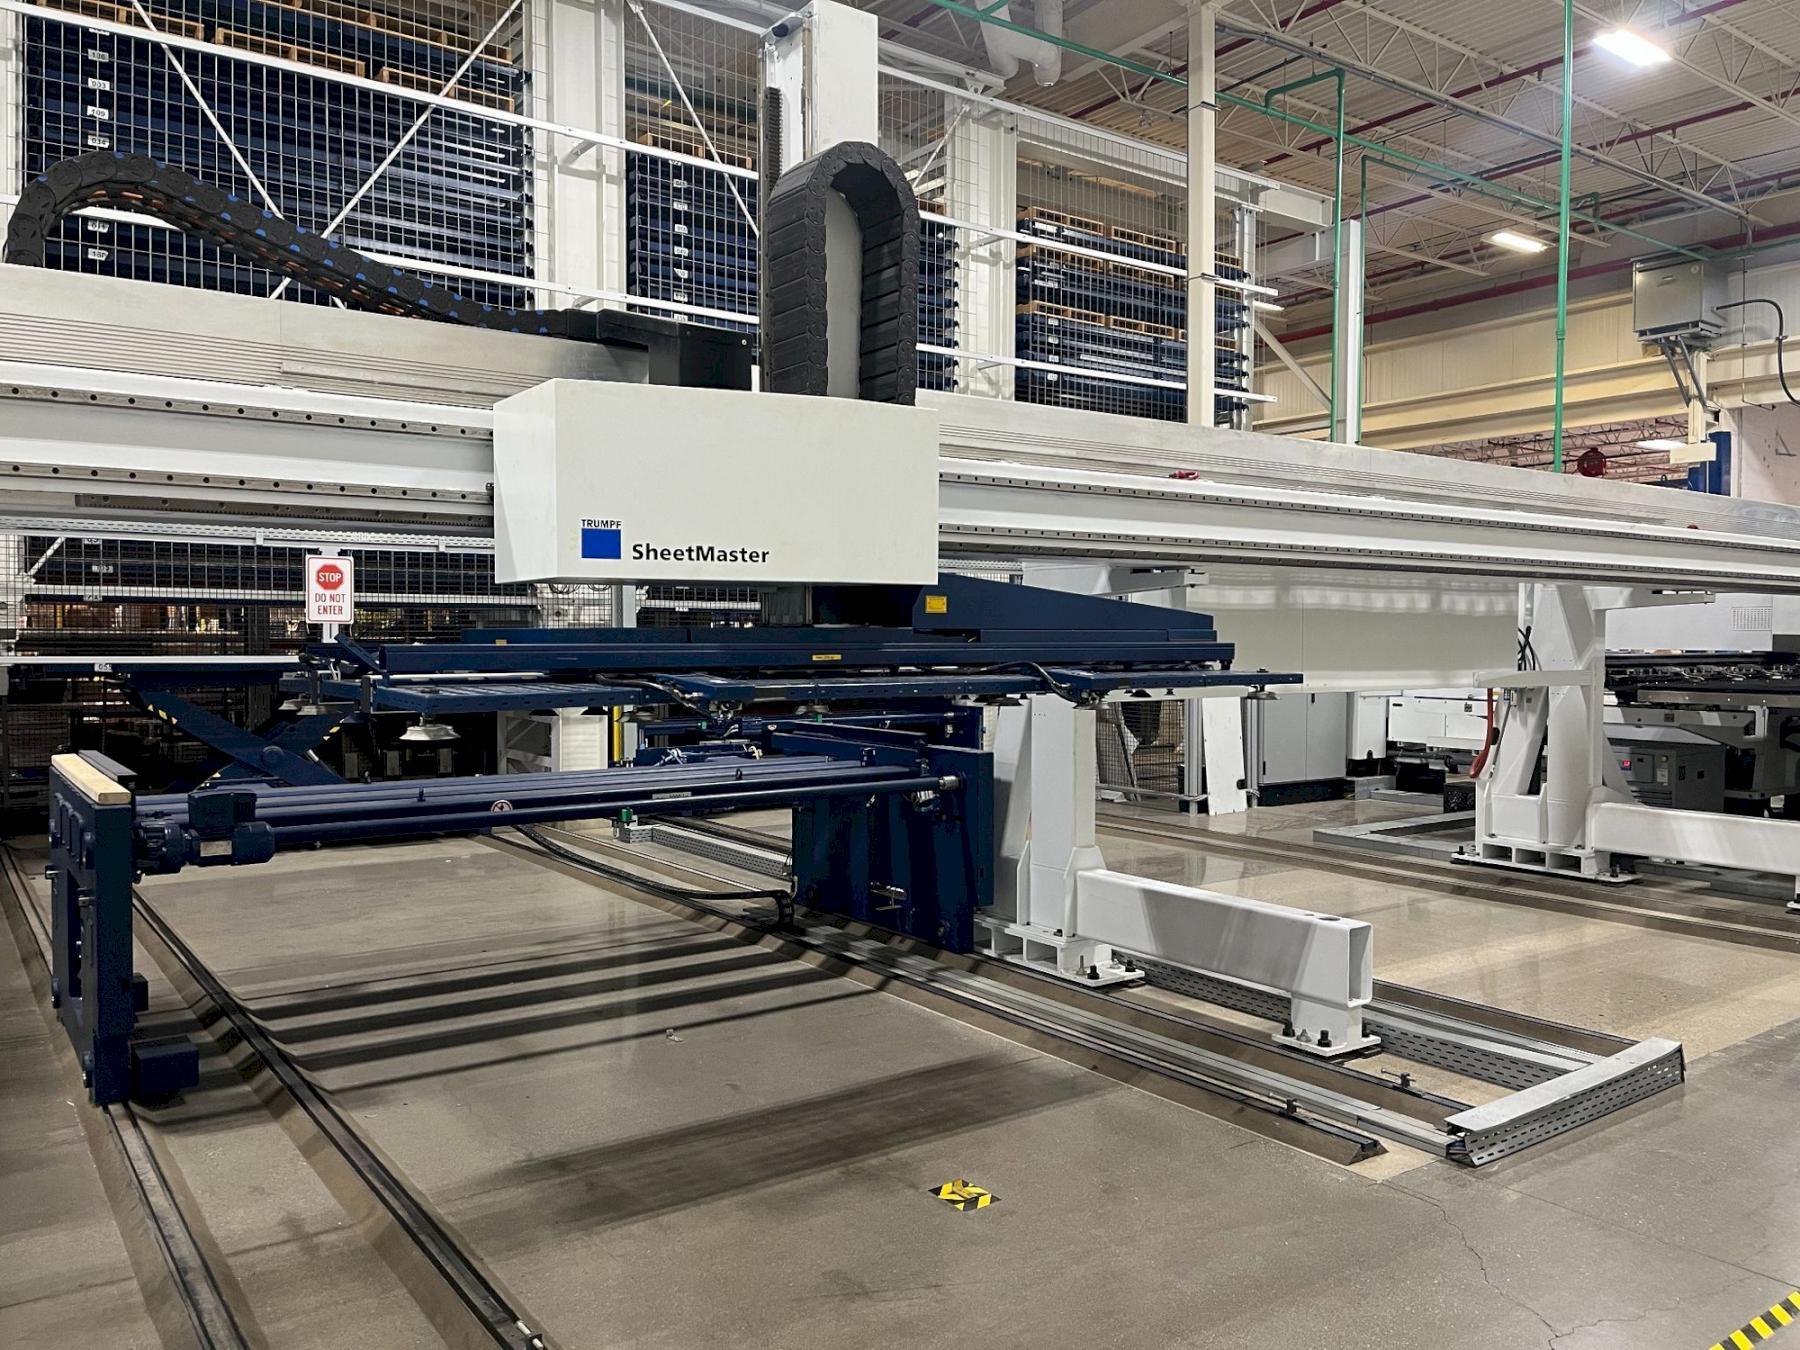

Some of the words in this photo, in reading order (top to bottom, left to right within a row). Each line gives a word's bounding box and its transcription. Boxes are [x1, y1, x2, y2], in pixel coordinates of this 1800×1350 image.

[581, 519, 622, 529] TRUMPF
[632, 543, 770, 563] SheetMaster
[319, 572, 342, 583] STOP
[315, 593, 326, 603] DO
[330, 593, 347, 603] NOT
[318, 605, 343, 615] ENTER
